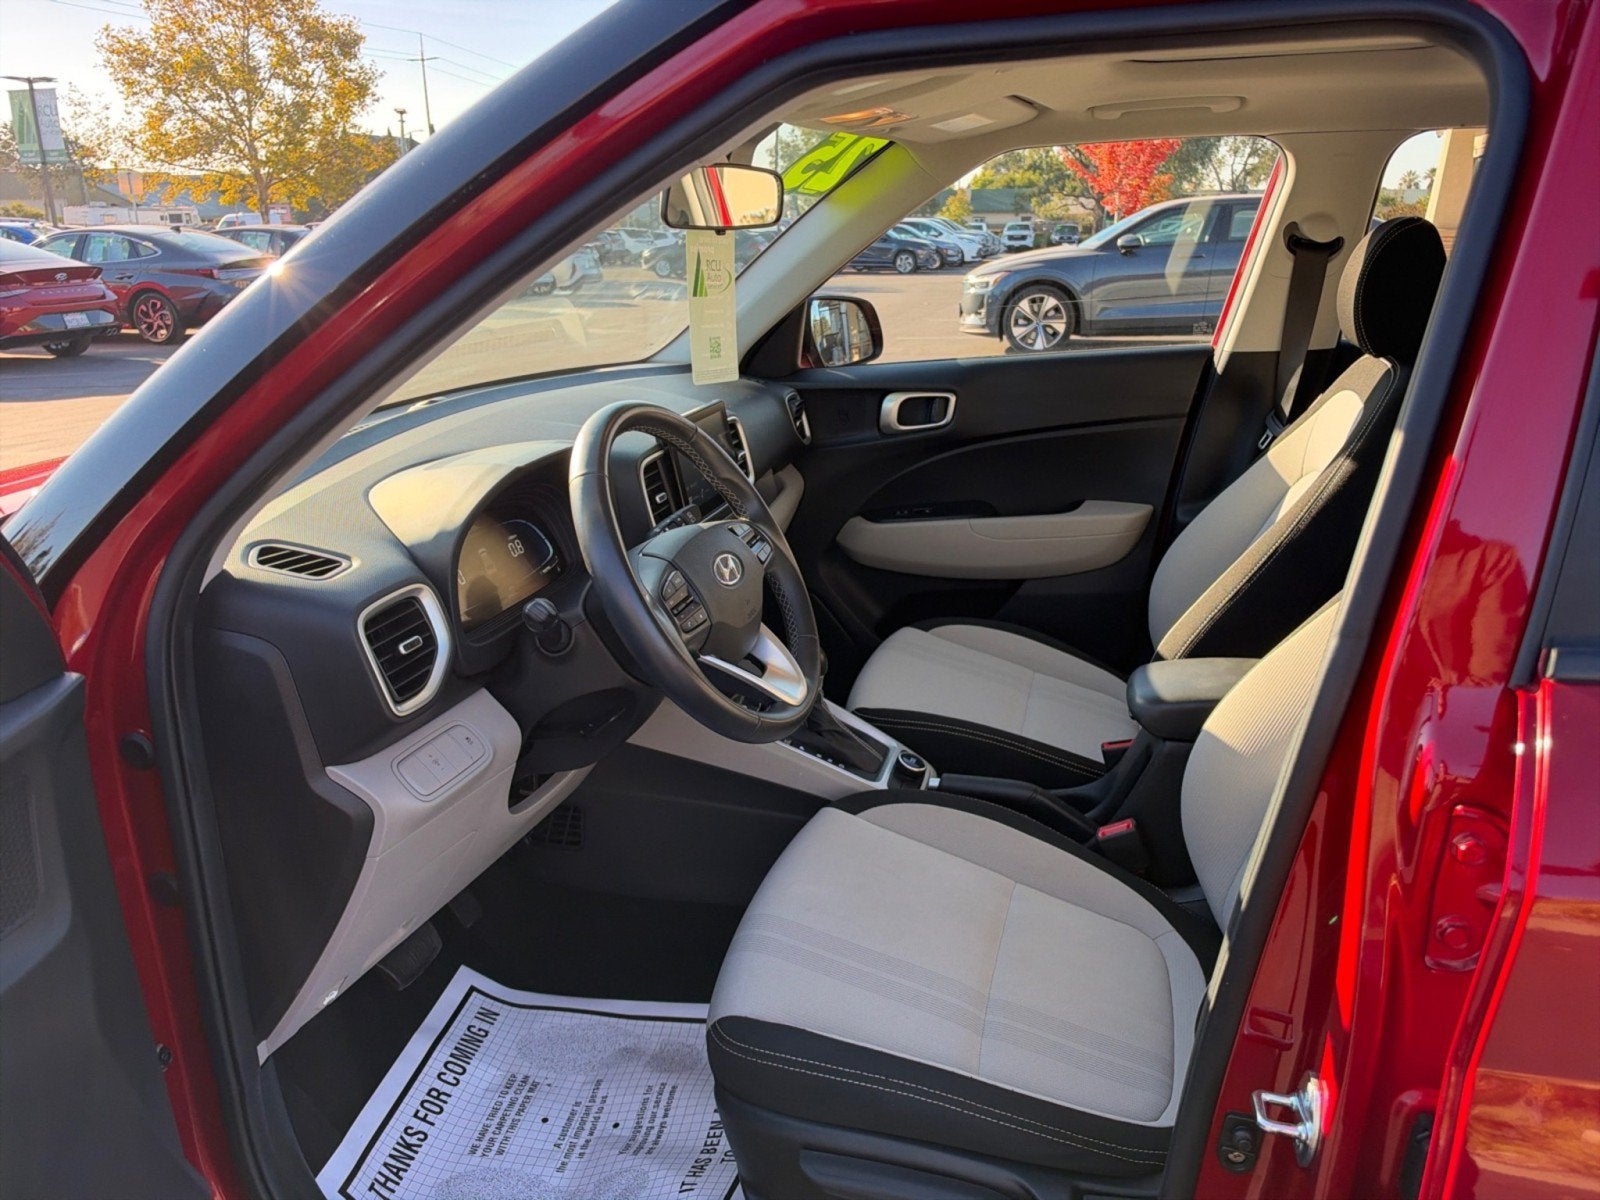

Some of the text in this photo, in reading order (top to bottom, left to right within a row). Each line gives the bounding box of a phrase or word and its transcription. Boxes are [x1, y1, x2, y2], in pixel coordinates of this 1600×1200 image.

[368, 1005, 501, 1200] THANKS FOR COMING IN
[468, 1073, 518, 1154] WE HAVE TRIED TO KEEP
[481, 1075, 530, 1157] YOUR CARPETING CLEAN
[495, 1079, 540, 1155] WITH THIS PAPER MAT
[557, 1108, 578, 1141] customer
[573, 1100, 581, 1108] is
[581, 1139, 592, 1150] the
[587, 1115, 601, 1136] world
[628, 1097, 649, 1142] suggestions
[648, 1111, 656, 1123] our
[652, 1082, 667, 1109] service
[555, 1161, 568, 1173] the
[563, 1140, 577, 1160] most
[572, 1105, 593, 1140] important
[679, 1121, 723, 1193] IT HAS BEEN
